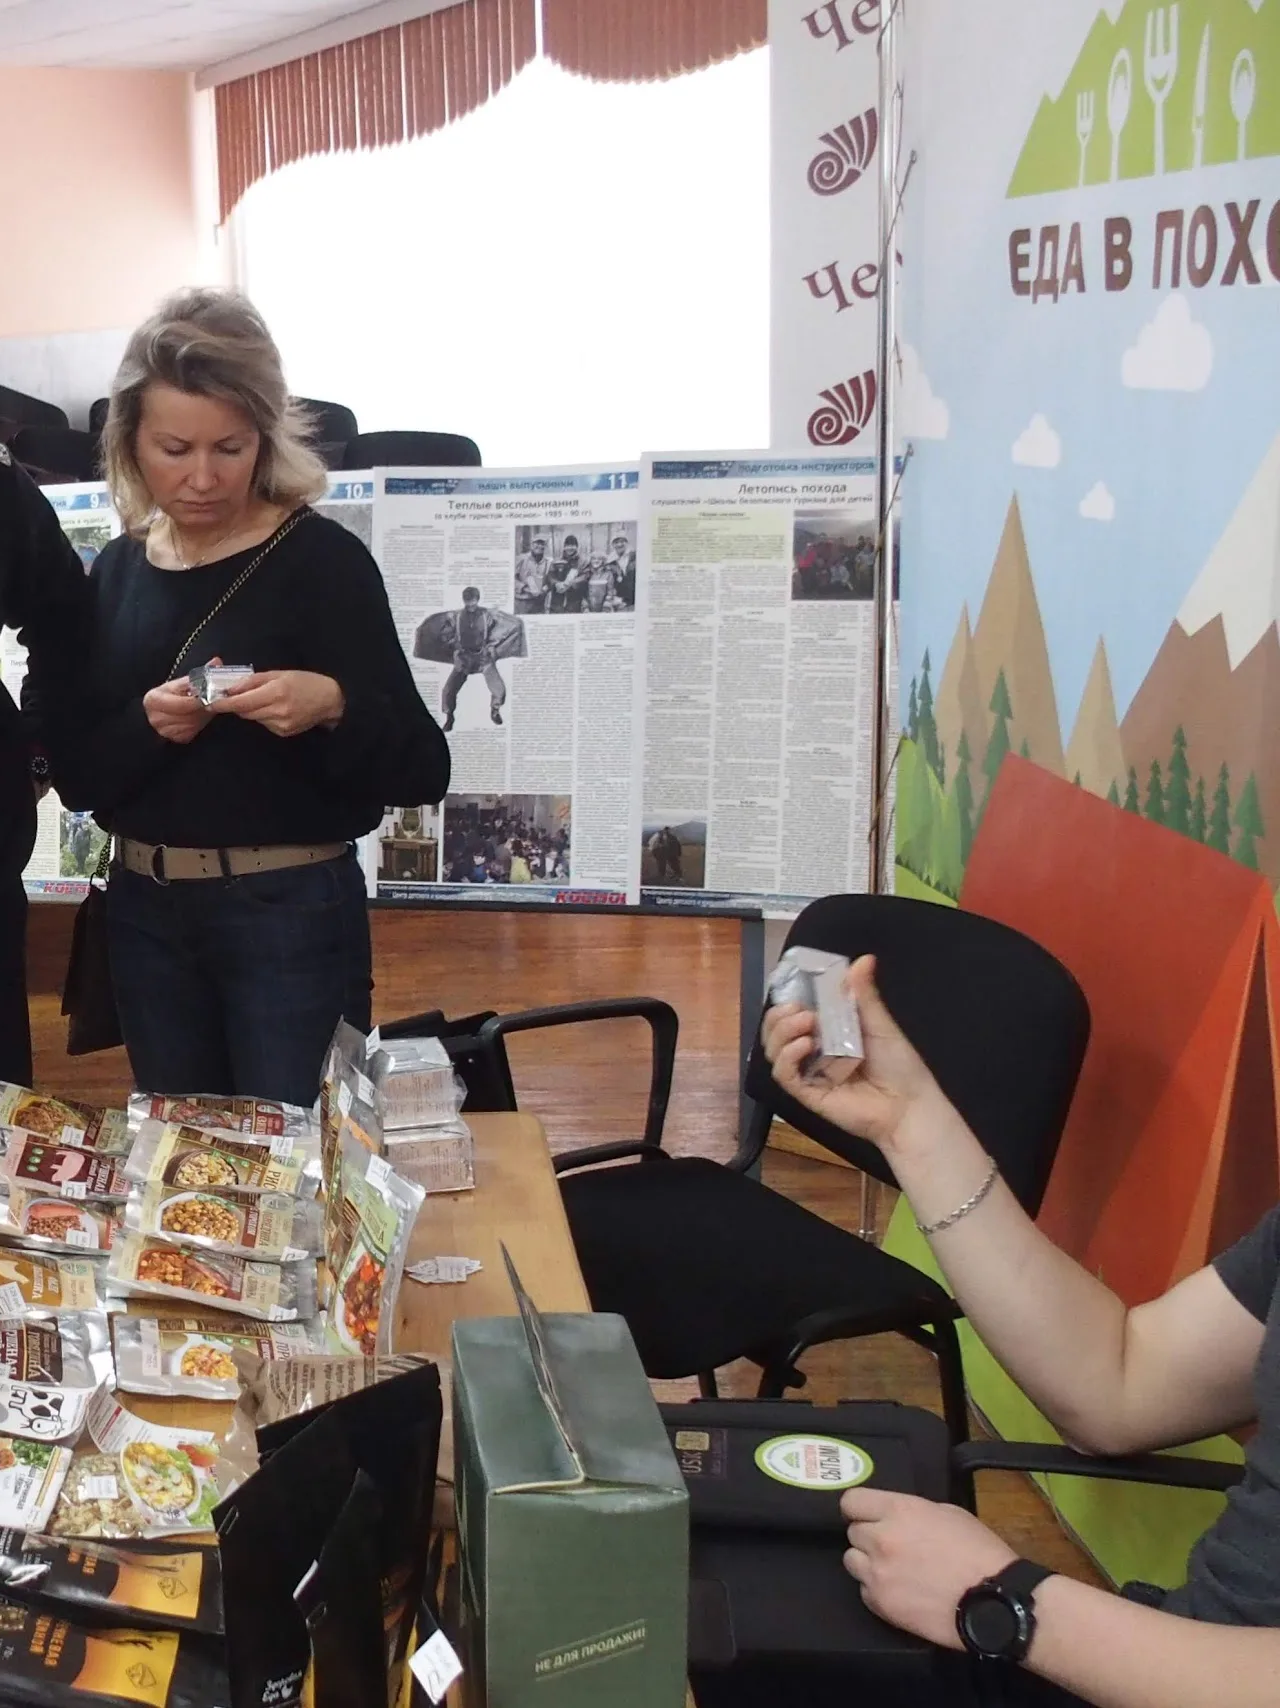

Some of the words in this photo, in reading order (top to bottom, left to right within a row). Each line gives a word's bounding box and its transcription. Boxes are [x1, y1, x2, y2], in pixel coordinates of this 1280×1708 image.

[1009, 221, 1087, 304] ЕДА
[1104, 216, 1134, 292] В
[738, 463, 798, 474] подготовка
[801, 461, 874, 472] инструкторов
[510, 480, 574, 491] выпускники
[608, 473, 627, 489] 11
[739, 483, 797, 495] Летопись
[802, 482, 847, 494] похода
[345, 484, 364, 499] 10
[90, 493, 99, 508] 9
[448, 500, 491, 510] Теплые
[495, 499, 579, 509] воспоминания
[43, 882, 91, 894] КОСМ
[263, 1170, 281, 1193] РИС
[819, 1445, 842, 1481] СЫТЫМ!
[535, 1659, 551, 1673] НЕ
[553, 1650, 579, 1669] ДЛЯ
[581, 1627, 646, 1658] ПРОДАЖИ!
